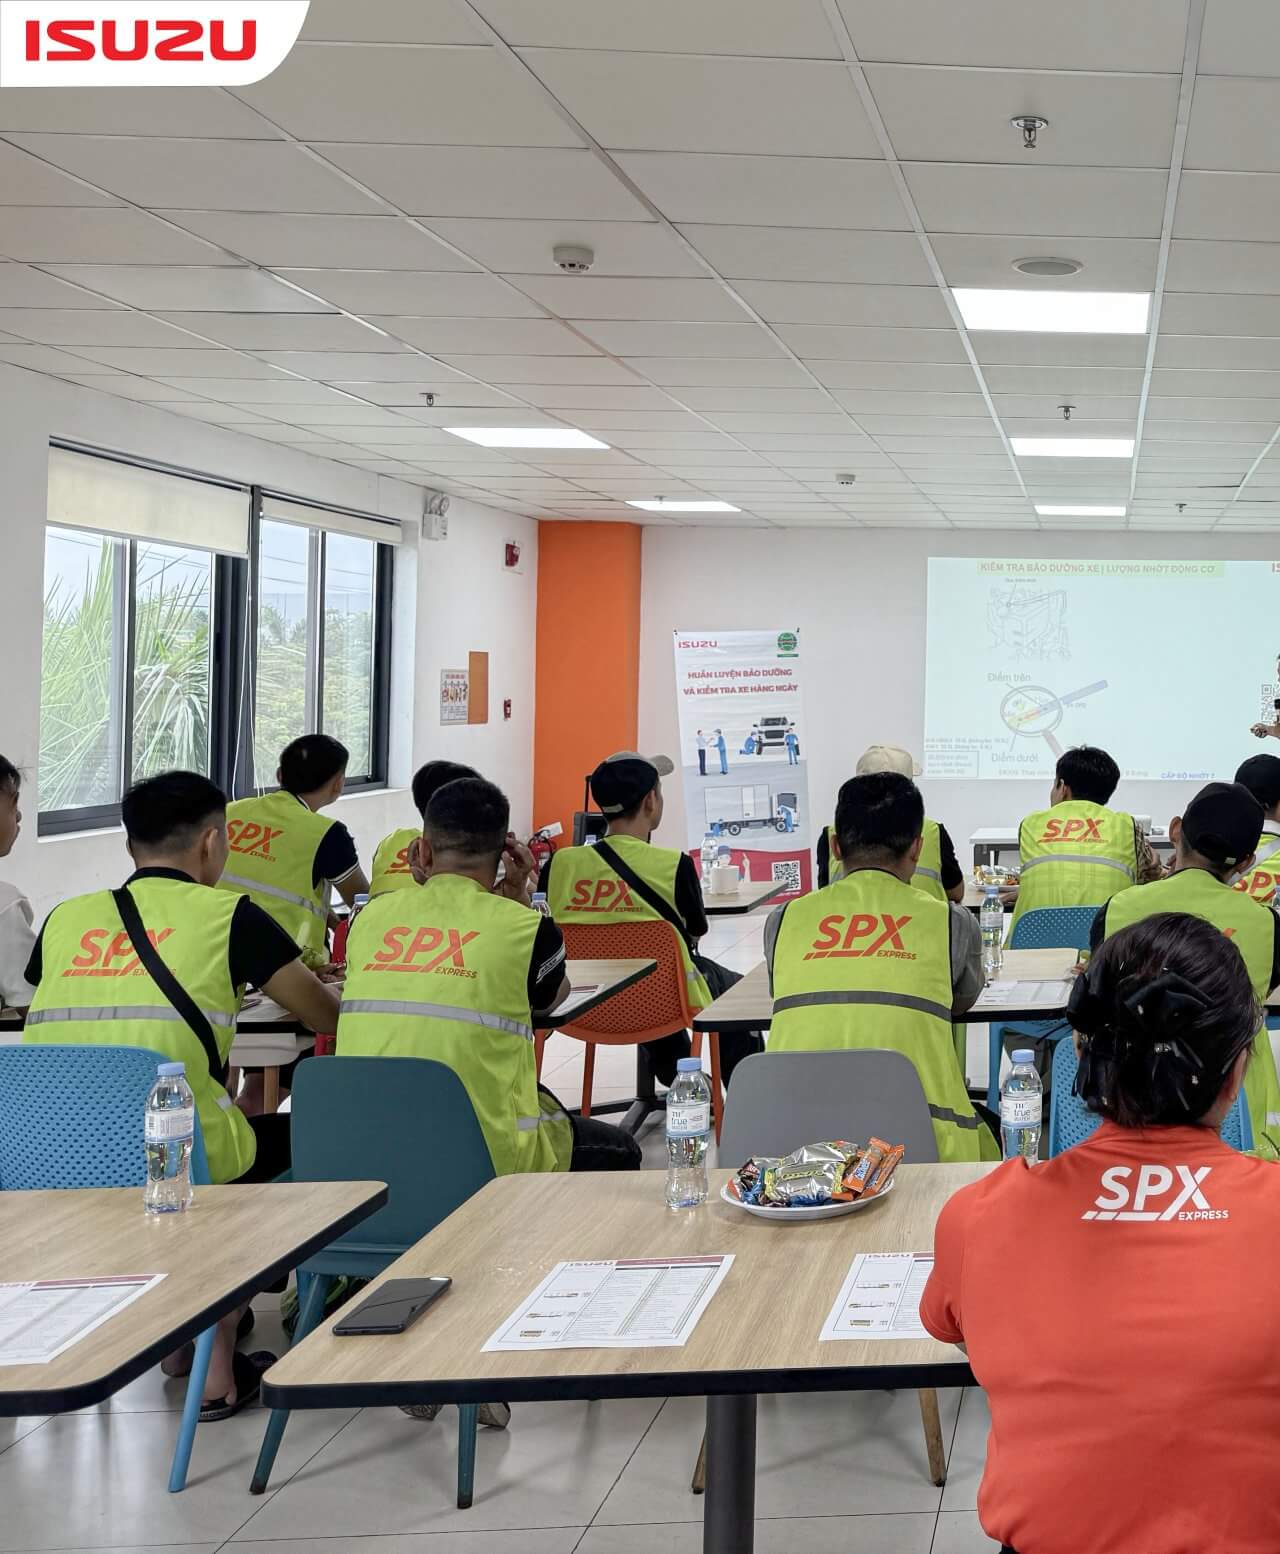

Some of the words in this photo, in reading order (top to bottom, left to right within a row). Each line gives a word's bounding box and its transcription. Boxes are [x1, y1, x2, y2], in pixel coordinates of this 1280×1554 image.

[1007, 563, 1025, 573] TRA
[1087, 563, 1100, 574] XE
[678, 640, 718, 649] ISUZU
[719, 686, 736, 694] TRA
[227, 819, 284, 853] SPX
[1043, 818, 1104, 842] SPX
[571, 879, 633, 912] SPX
[812, 914, 913, 958] SPX
[374, 927, 480, 973] SPX
[877, 949, 918, 961] EXPRESS
[435, 965, 477, 979] EXPRESS
[1014, 1109, 1031, 1117] true
[671, 1117, 688, 1125] true
[1094, 1164, 1213, 1221] SPX
[1178, 1209, 1229, 1221] EXPRESS
